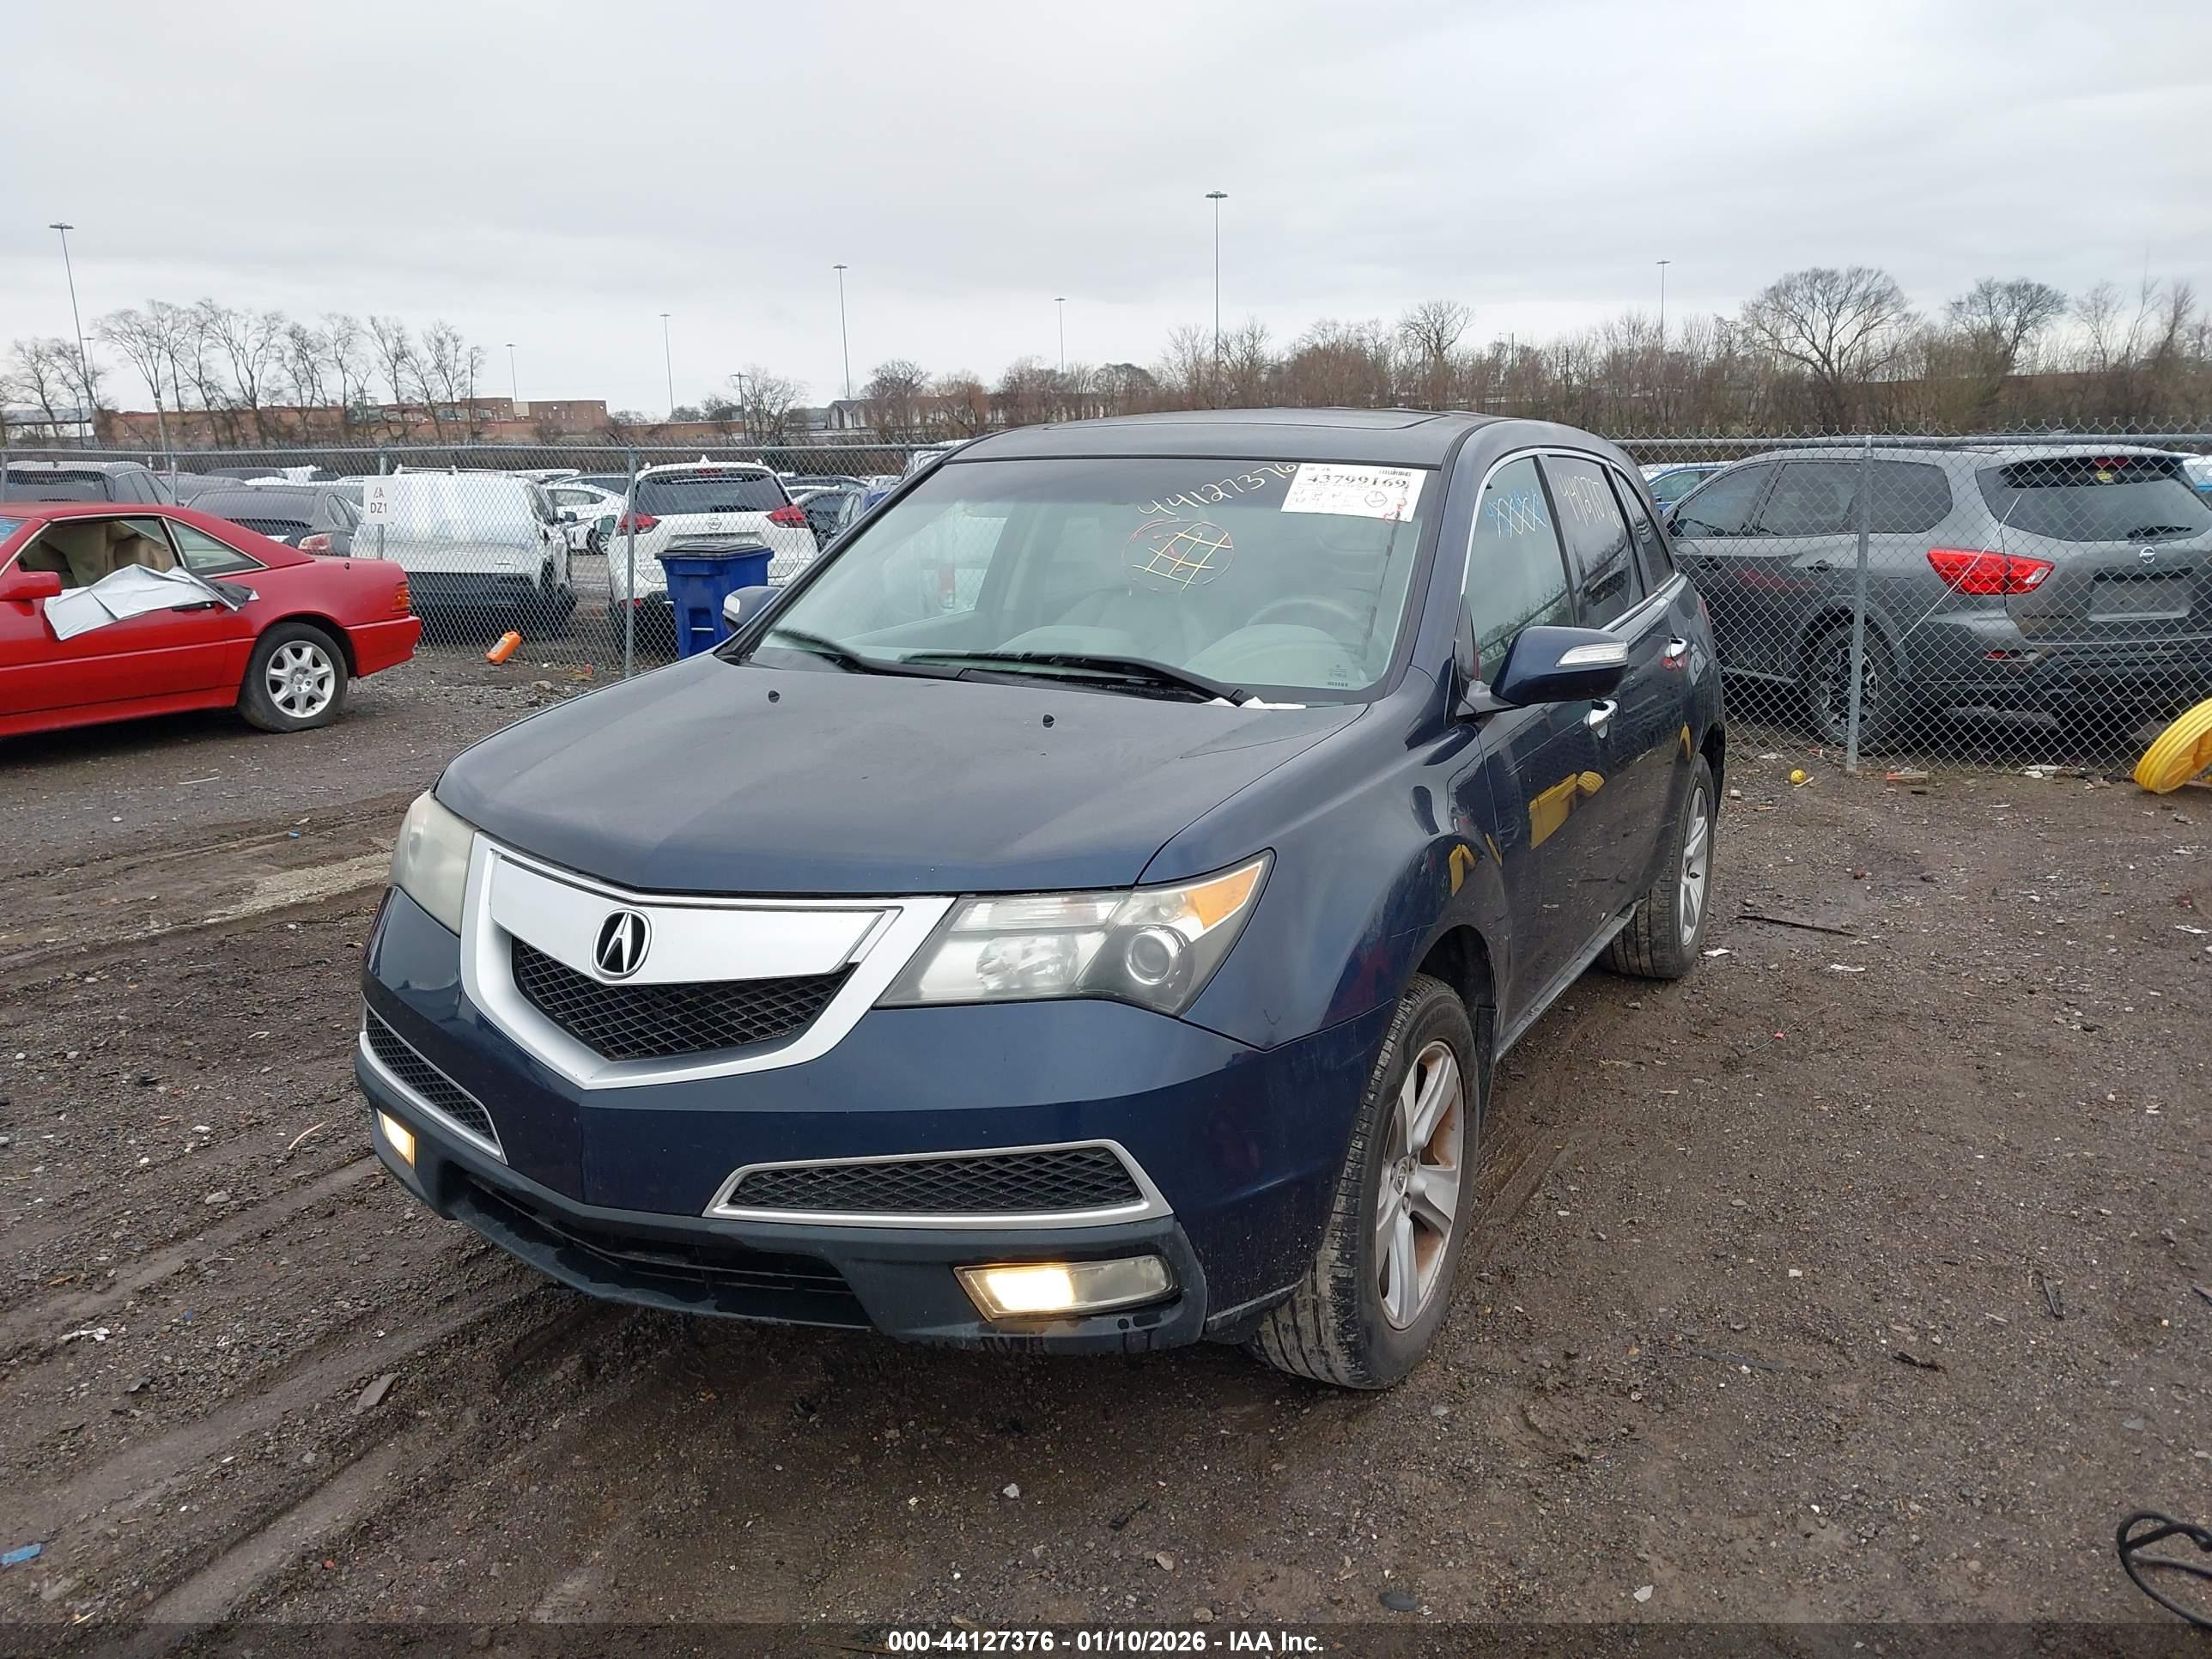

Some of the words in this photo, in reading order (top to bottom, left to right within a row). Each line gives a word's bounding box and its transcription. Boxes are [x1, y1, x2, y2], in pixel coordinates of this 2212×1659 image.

[1307, 473, 1409, 489] 43799169
[1138, 463, 1297, 516] 44127376
[370, 501, 387, 514] DZ1
